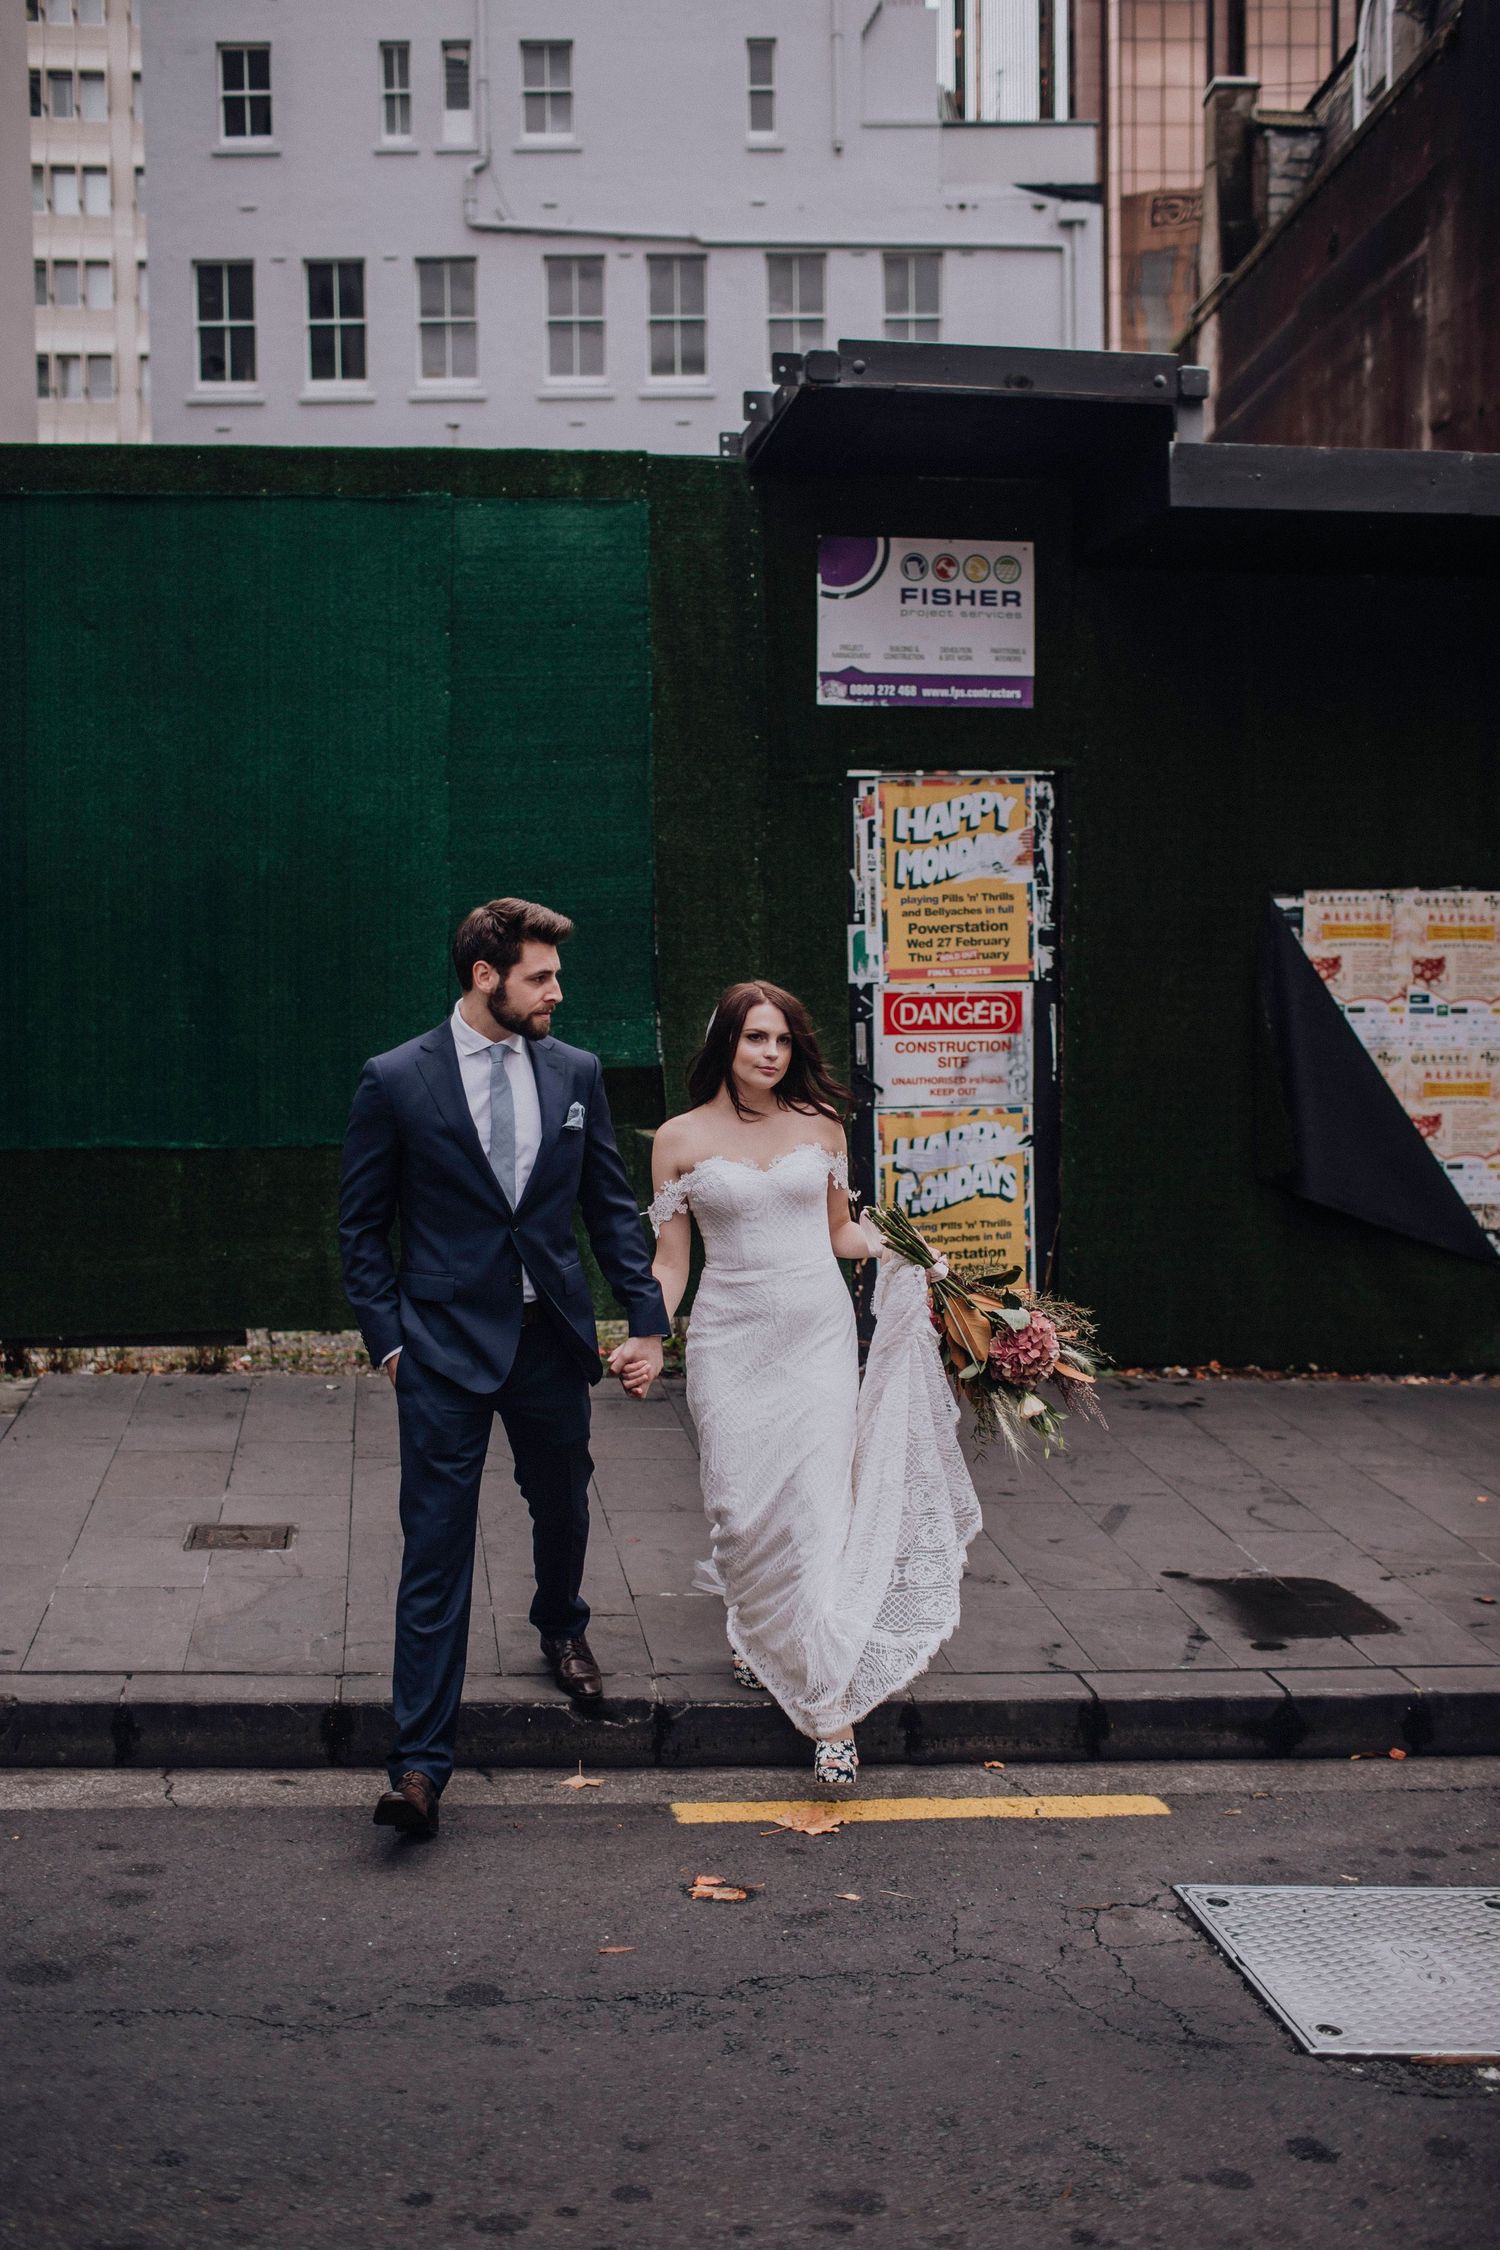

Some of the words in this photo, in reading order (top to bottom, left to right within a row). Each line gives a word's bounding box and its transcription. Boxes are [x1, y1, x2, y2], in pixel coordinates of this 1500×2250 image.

[901, 588, 1022, 607] FISHER
[877, 684, 896, 696] 272
[893, 791, 1018, 844] HAPPY
[901, 895, 939, 905] playing
[942, 893, 964, 903] Pills
[982, 892, 1015, 901] Thrills
[901, 908, 921, 917] and
[924, 906, 982, 918] Bellyaches
[985, 906, 995, 914] in
[998, 905, 1014, 914] full
[908, 920, 1009, 935] Powerstation
[906, 938, 933, 949] Wed
[937, 937, 952, 948] 27
[955, 937, 1010, 949] February
[908, 952, 932, 962] Thu
[899, 1000, 1008, 1026] DANGER
[895, 1040, 1012, 1053] CONSTRUCTION
[938, 1056, 969, 1068] SITE
[891, 1076, 967, 1086] UNAUTHORISED
[929, 1088, 955, 1096] KEEP
[958, 1087, 977, 1096] OUT
[941, 1221, 962, 1230] Pills
[980, 1219, 1012, 1228] Thrills
[984, 1233, 993, 1241] in
[996, 1231, 1012, 1240] full
